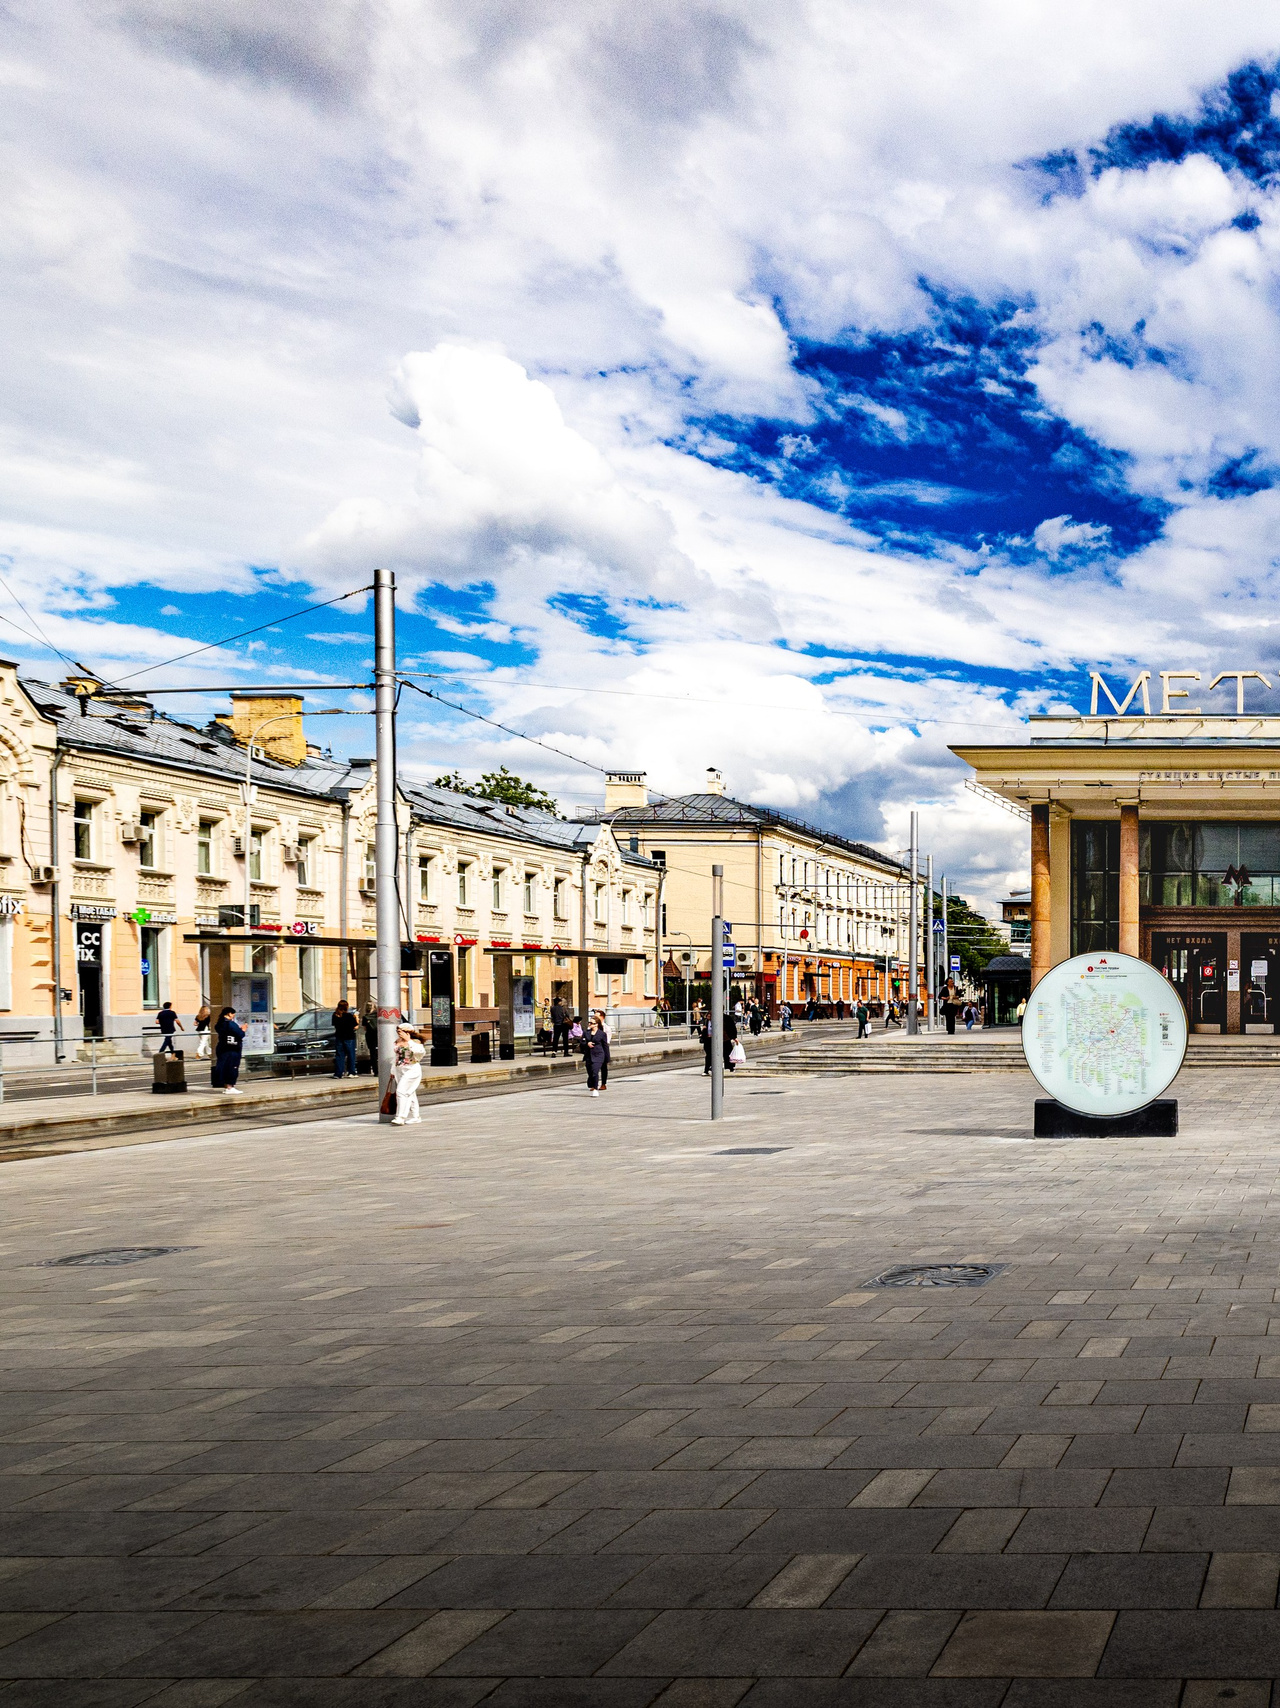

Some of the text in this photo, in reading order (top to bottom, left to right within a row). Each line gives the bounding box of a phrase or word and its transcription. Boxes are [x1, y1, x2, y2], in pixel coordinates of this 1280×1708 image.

[1138, 771, 1200, 780] СТАНЦИЯ
[1207, 771, 1261, 780] ЧИСТЫЕ
[0, 895, 24, 914] fix
